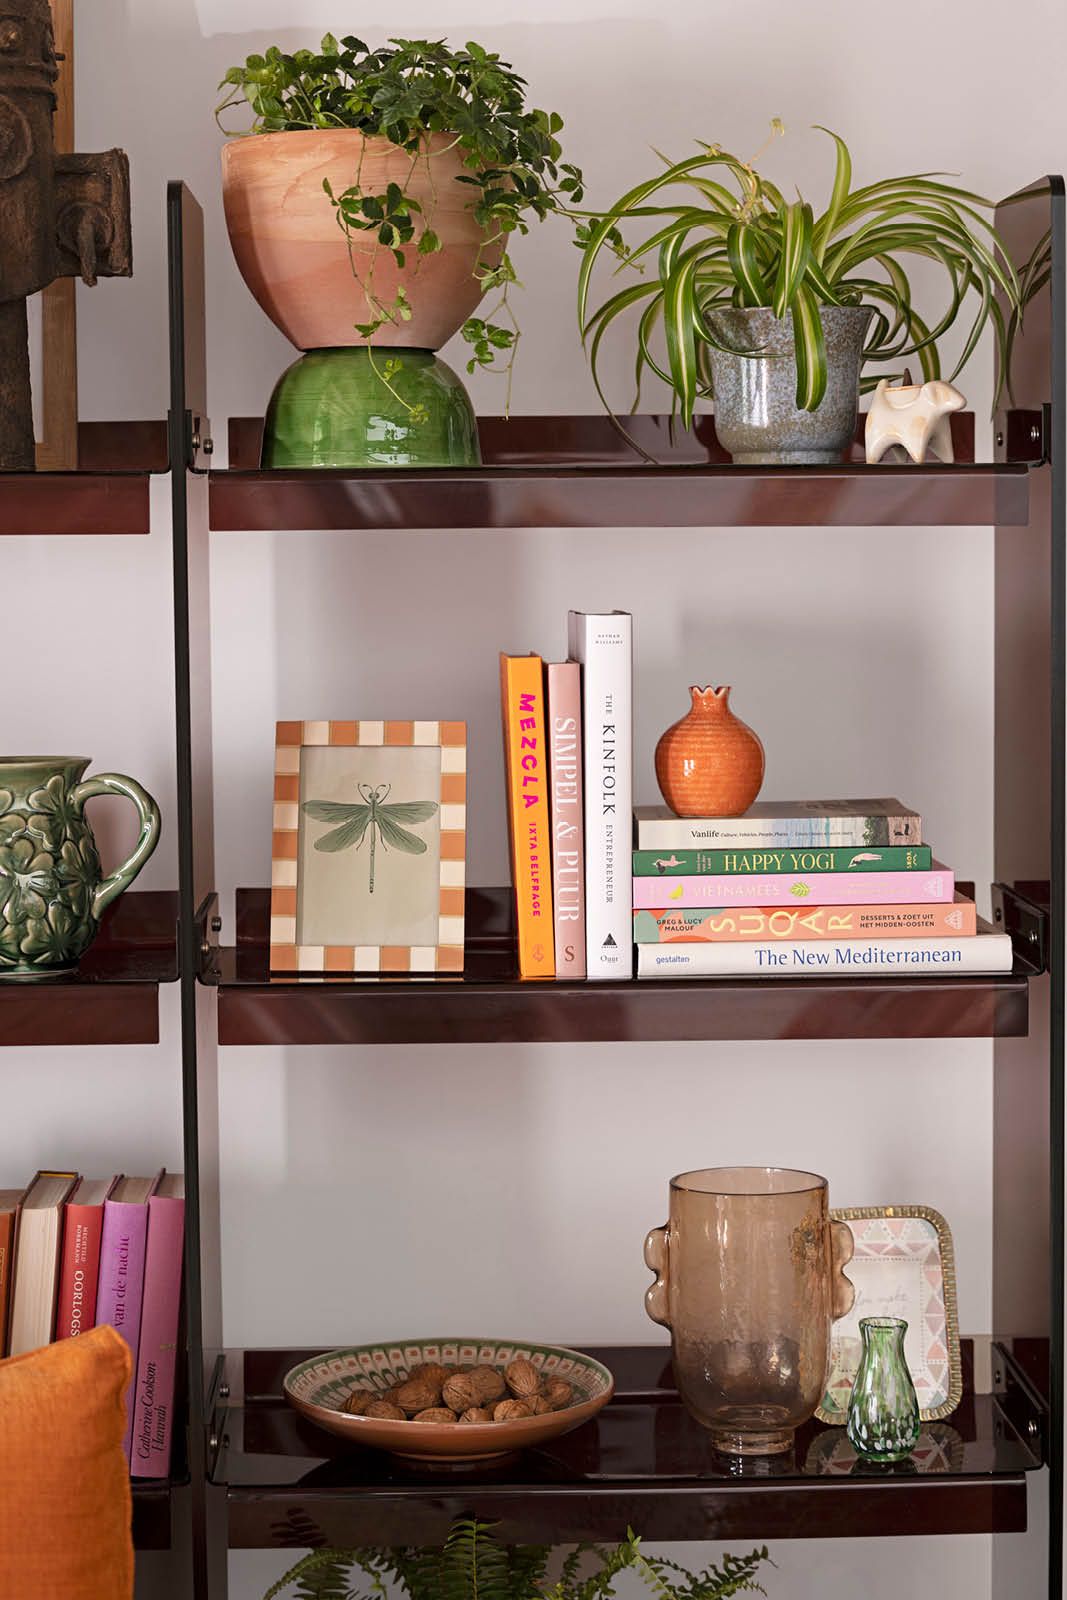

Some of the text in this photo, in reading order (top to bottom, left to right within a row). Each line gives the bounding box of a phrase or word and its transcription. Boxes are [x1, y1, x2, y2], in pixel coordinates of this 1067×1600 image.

[519, 693, 539, 808] MEZCLA
[602, 724, 616, 815] KINFOLK
[554, 717, 580, 921] SIMPEL & PUUR
[691, 830, 720, 838] Vanlife
[528, 823, 541, 917] IXTA BELFRAGE
[605, 824, 613, 903] ENTREPRENEUR
[724, 854, 784, 871] HAPPY
[790, 853, 835, 871] YOGI
[564, 945, 575, 962] S
[656, 955, 690, 964] gestalten
[755, 947, 962, 965] The New Mediterranean
[112, 1280, 126, 1299] de
[114, 1301, 126, 1327] van
[137, 1362, 156, 1459] Catherine Cookson
[152, 1405, 167, 1451] Hannah
